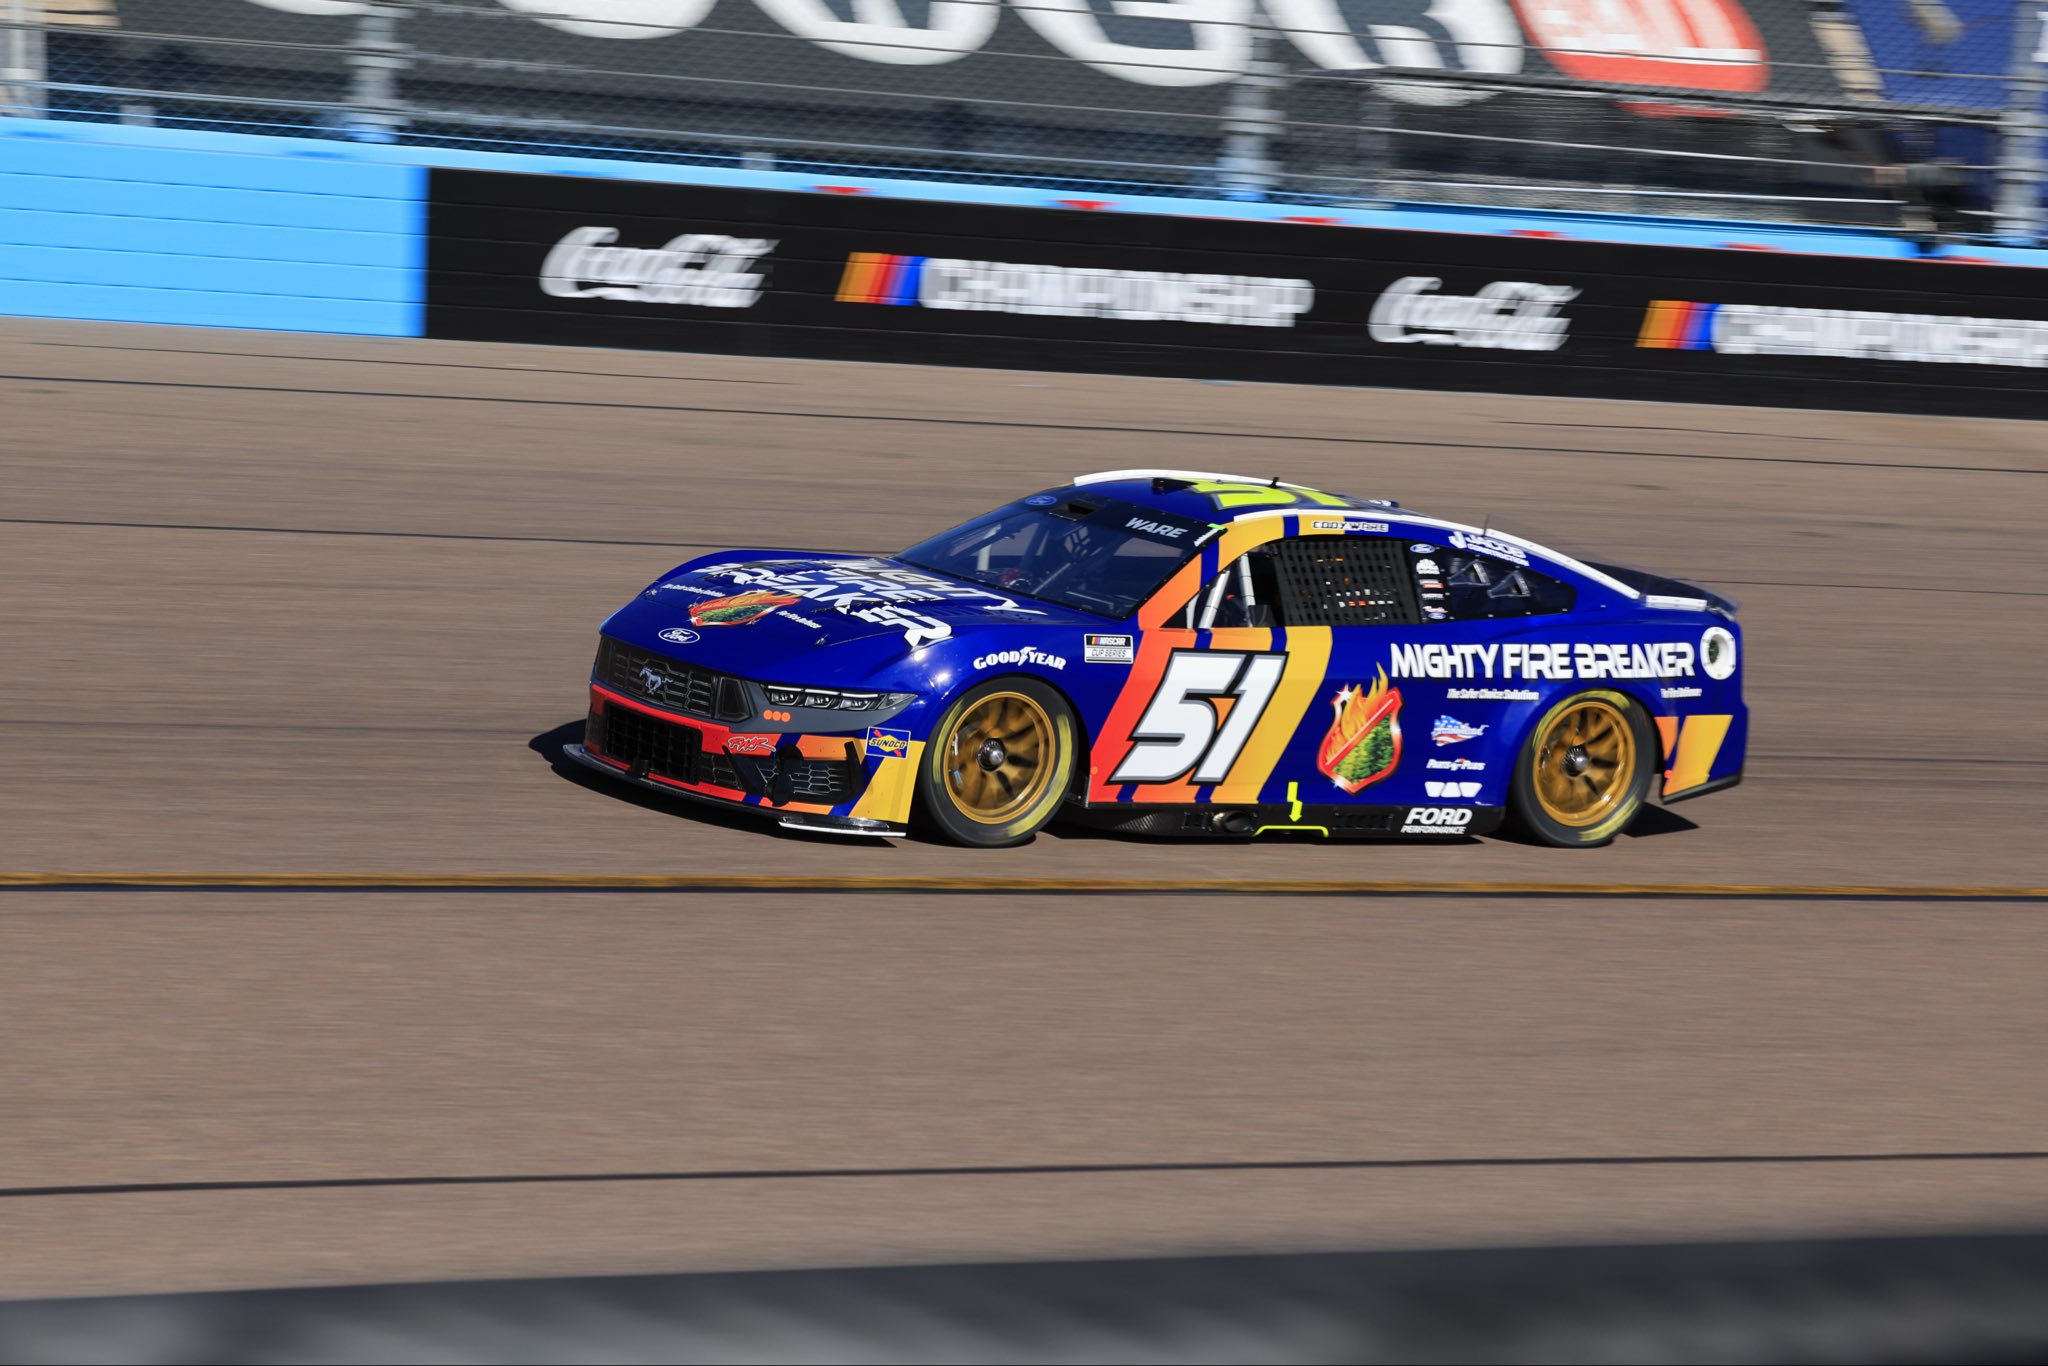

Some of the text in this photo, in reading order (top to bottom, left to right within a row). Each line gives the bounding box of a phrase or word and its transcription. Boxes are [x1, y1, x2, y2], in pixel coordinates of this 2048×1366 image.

[920, 257, 1315, 328] CHAMPIONSHIP
[1125, 517, 1189, 538] WARE
[1100, 636, 1127, 647] NASCAR
[973, 646, 1067, 671] GOODYEAR
[1091, 649, 1127, 659] CUP SERIES
[1389, 642, 1696, 680] MIGHTY FIRE BREAKER
[1104, 647, 1290, 786] 51
[869, 737, 908, 750] SUNOCO
[1404, 807, 1474, 826] FORD
[1400, 825, 1467, 835] PERFORMANCE
